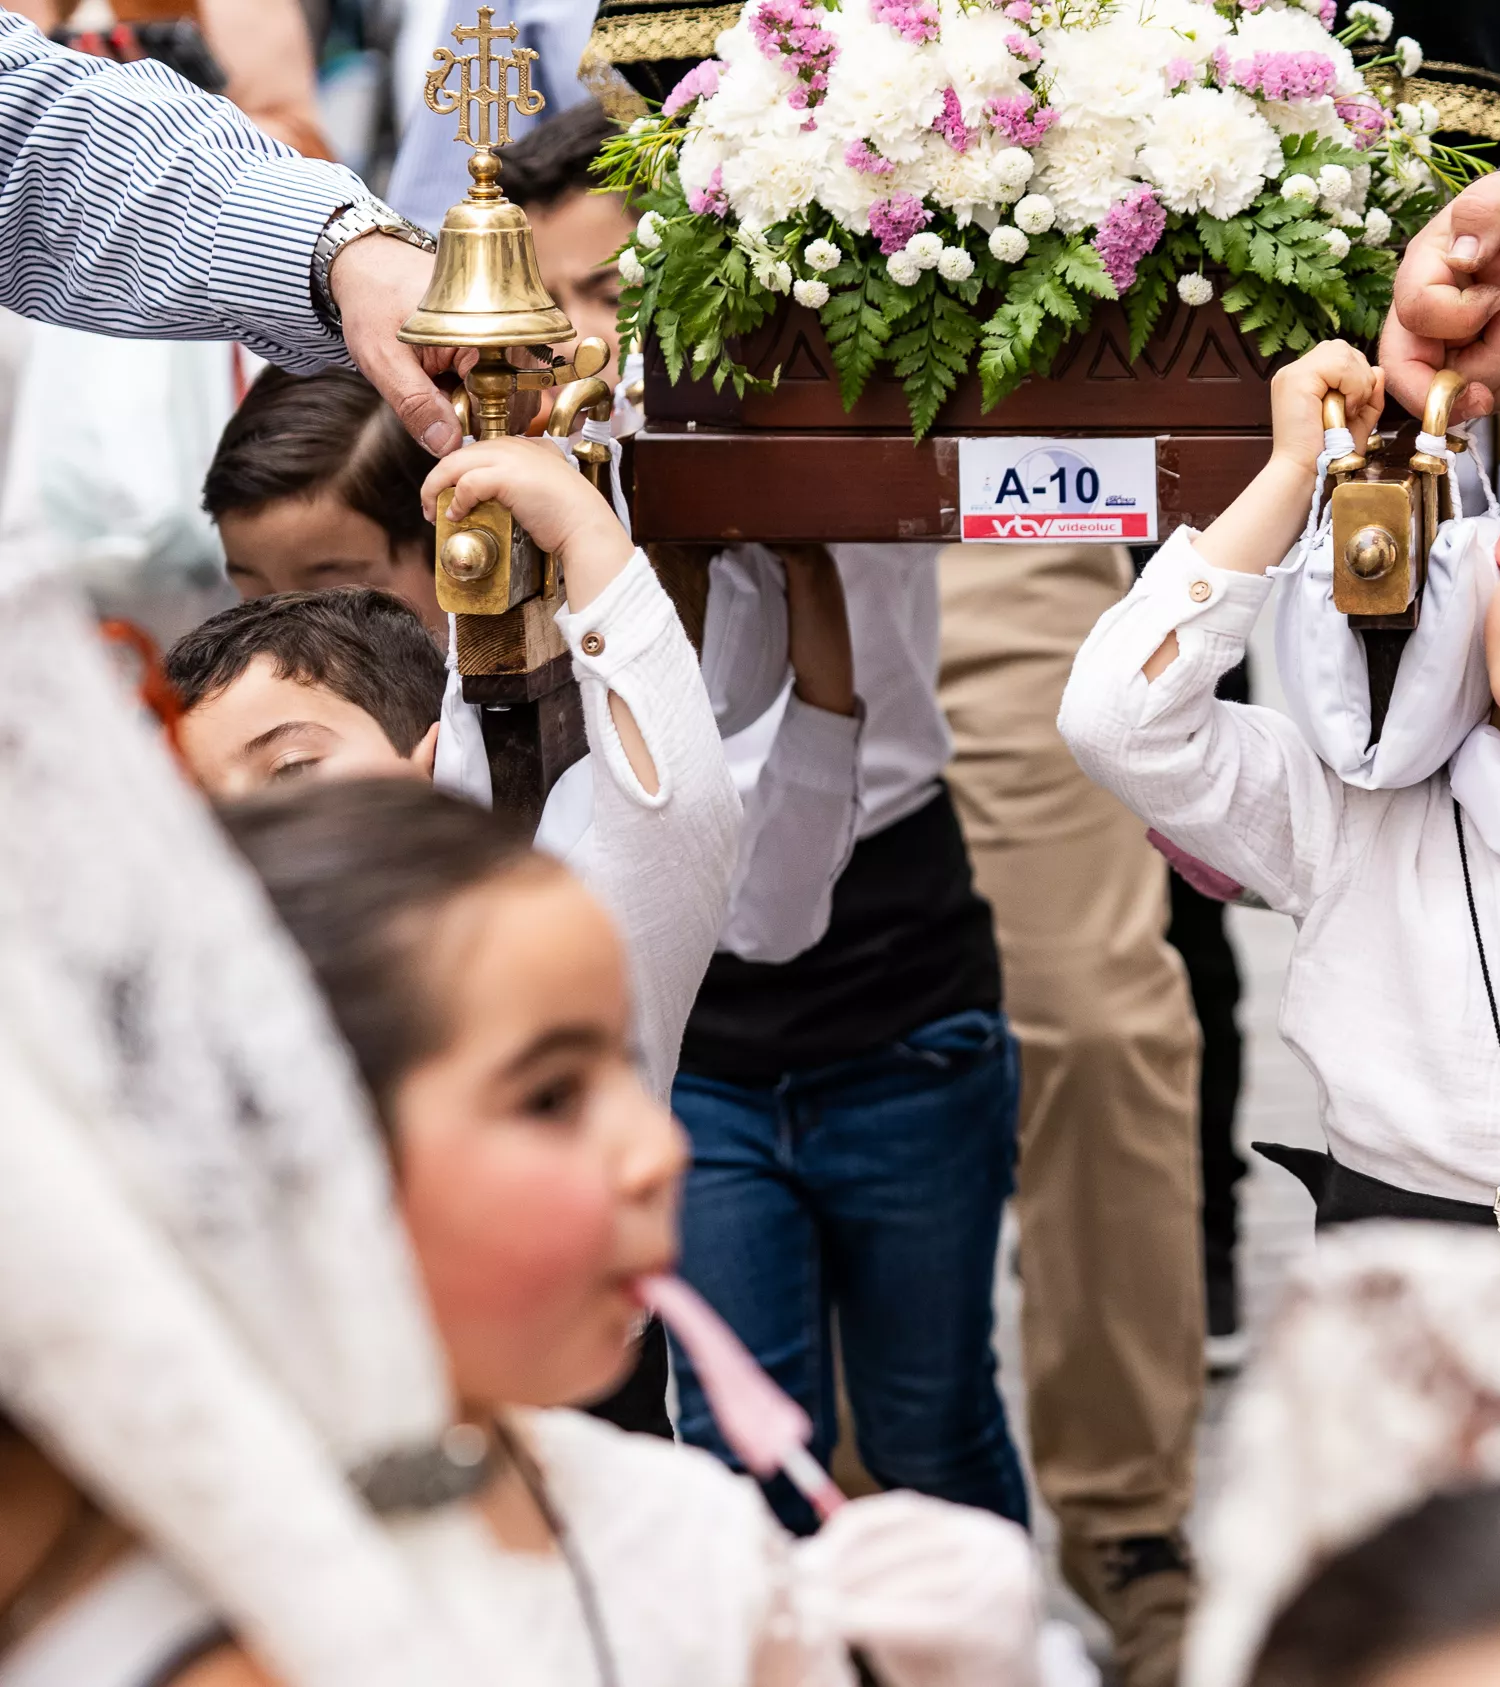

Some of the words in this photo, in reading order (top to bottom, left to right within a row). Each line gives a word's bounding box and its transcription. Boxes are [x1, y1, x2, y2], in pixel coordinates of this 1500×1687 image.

[995, 466, 1099, 504] A-10
[992, 514, 1052, 536] vtv
[1058, 522, 1116, 532] videoluc
